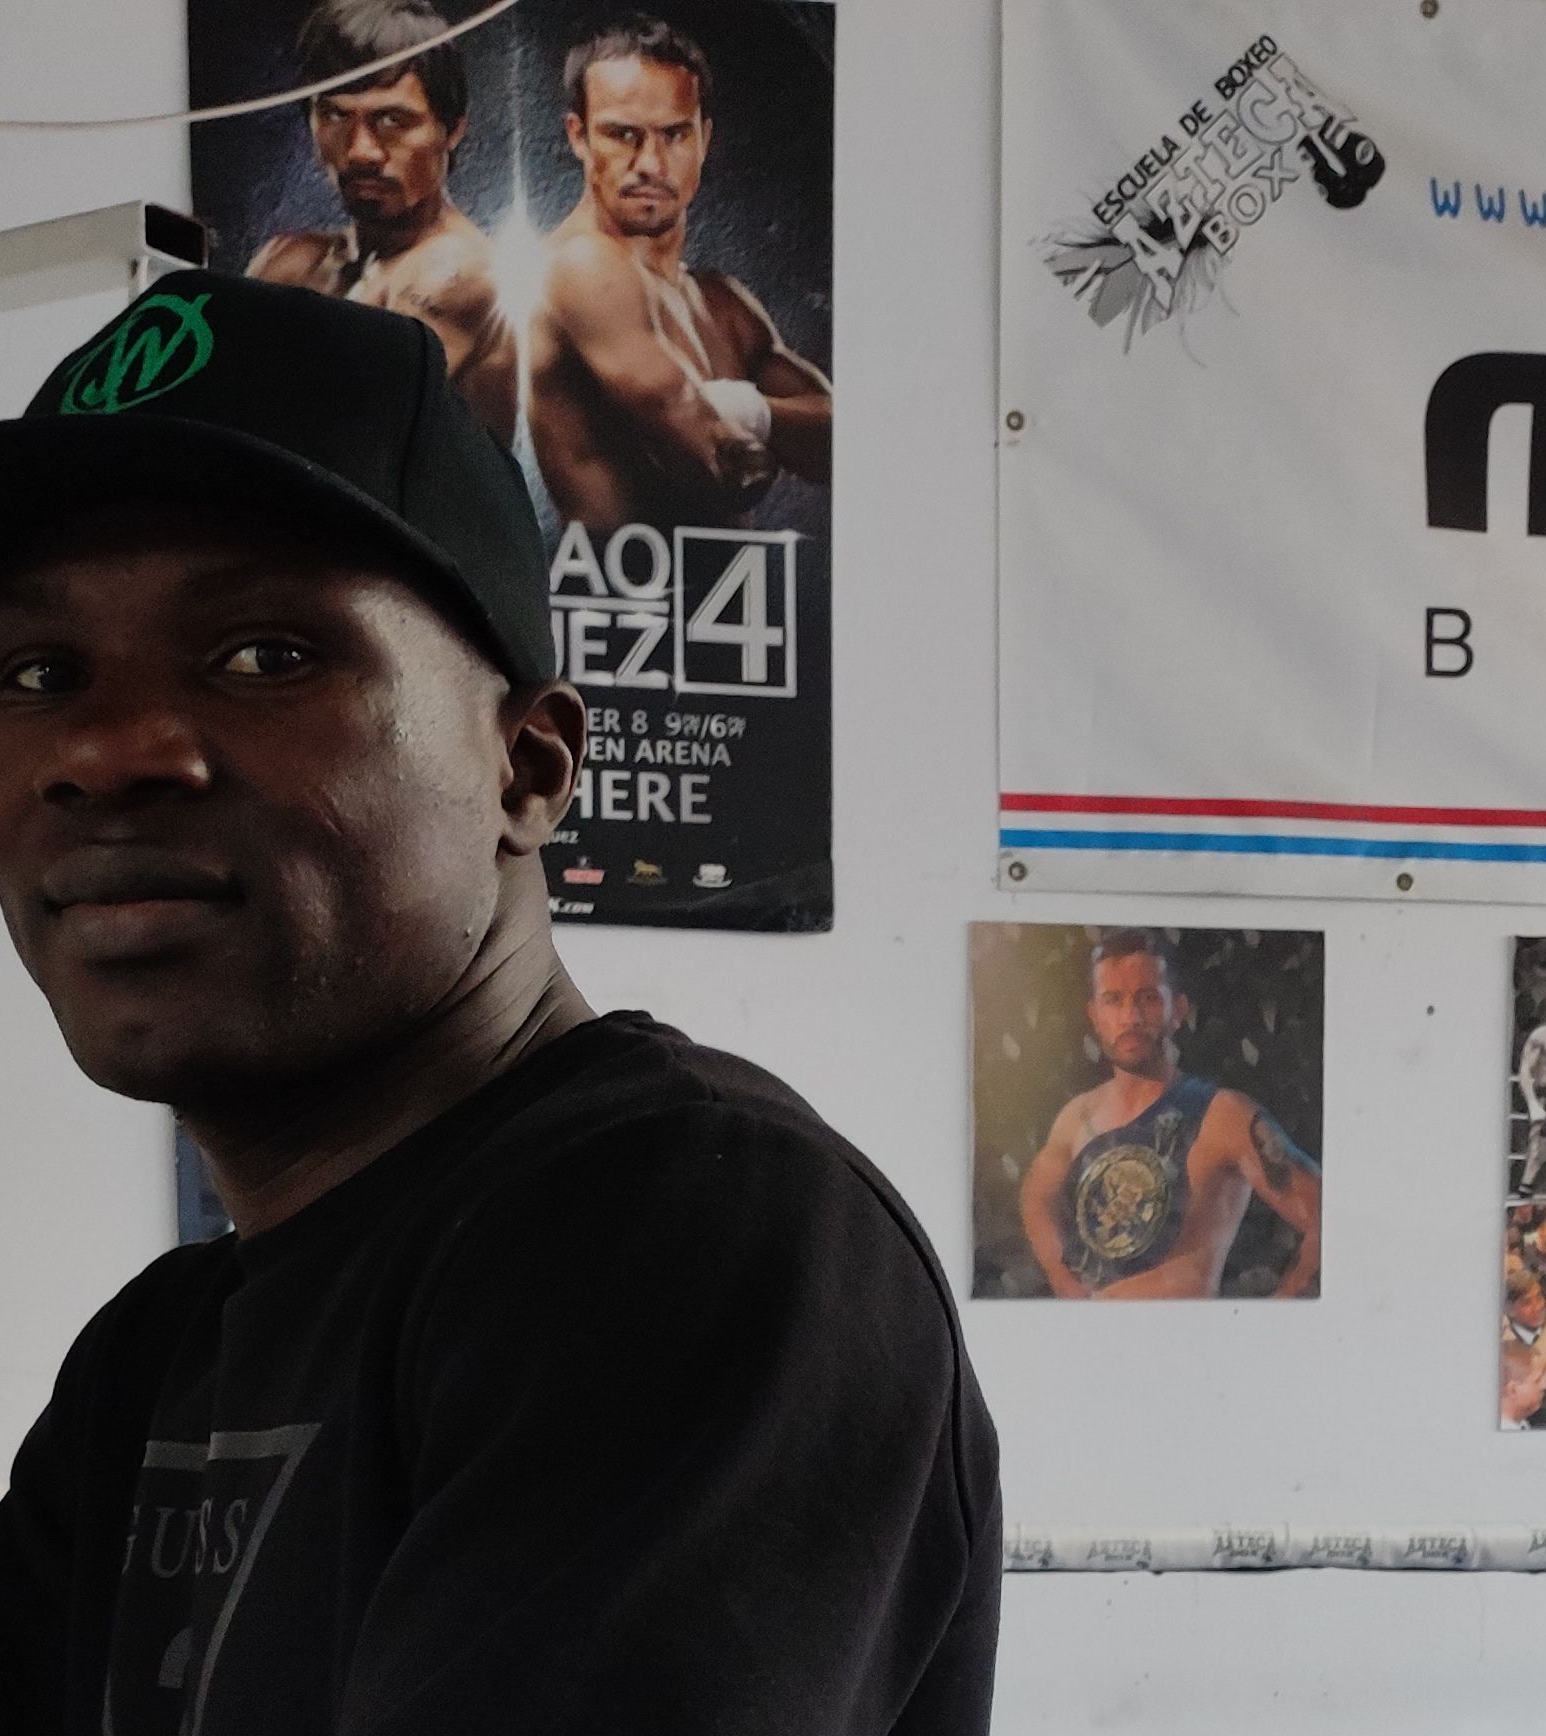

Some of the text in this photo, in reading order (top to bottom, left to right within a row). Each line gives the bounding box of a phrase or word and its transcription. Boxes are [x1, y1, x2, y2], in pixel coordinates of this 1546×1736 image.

[1093, 34, 1278, 225] ESCUELA DE BOXEO
[550, 521, 671, 599] AO
[687, 544, 784, 684] 4
[587, 707, 621, 733] ER
[631, 709, 649, 735] 8
[588, 736, 732, 767] EN ARENA
